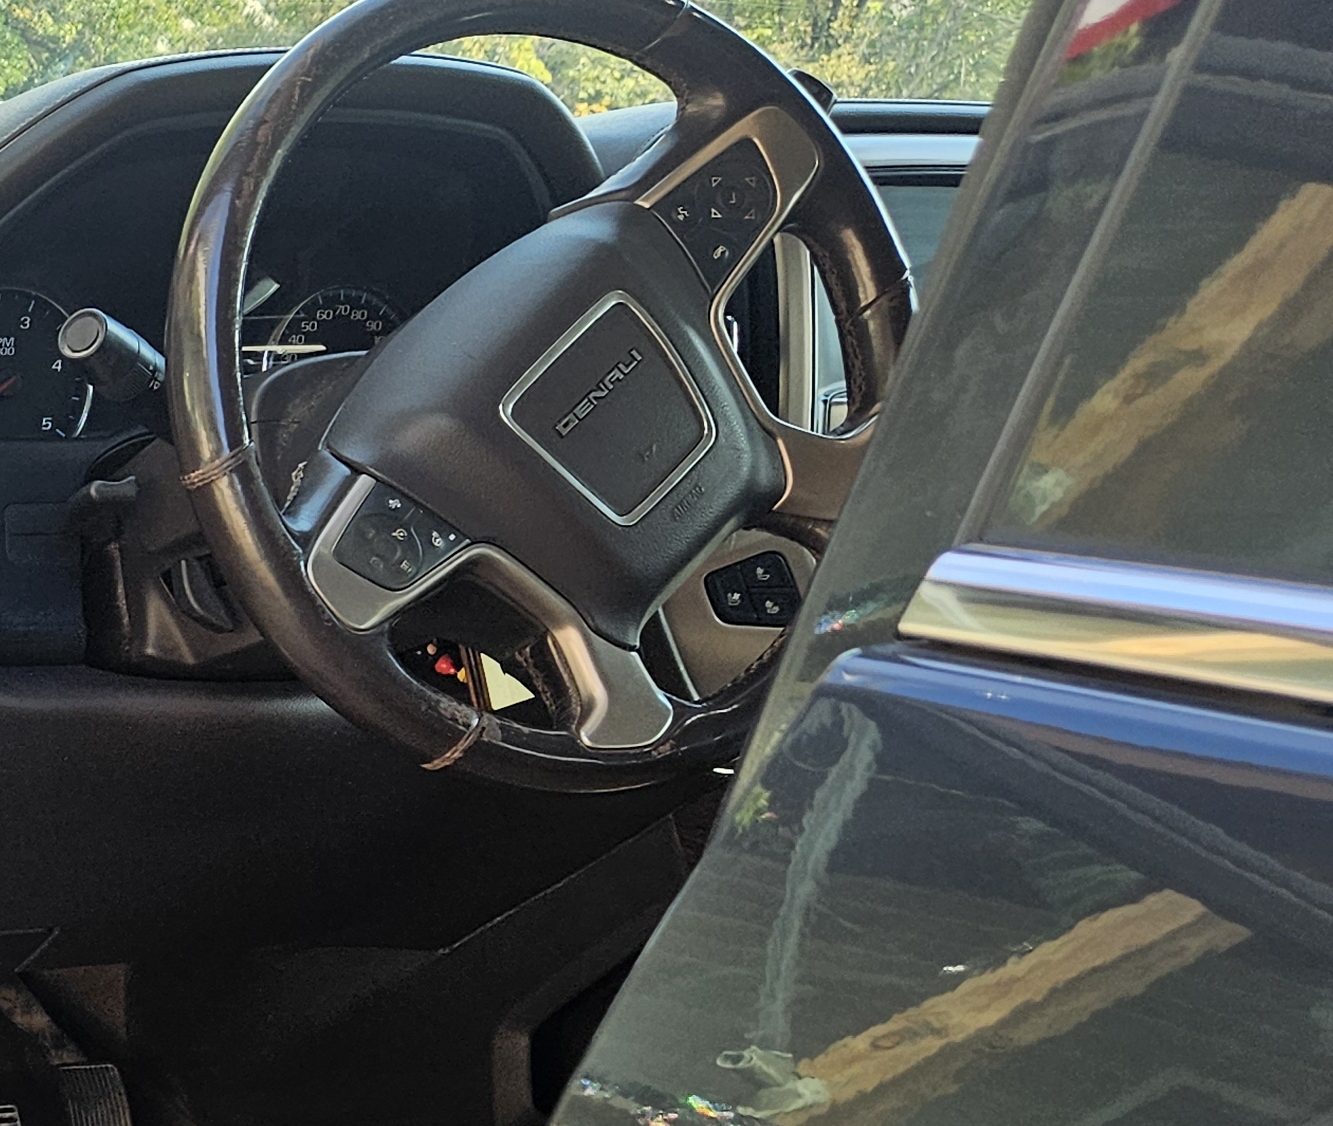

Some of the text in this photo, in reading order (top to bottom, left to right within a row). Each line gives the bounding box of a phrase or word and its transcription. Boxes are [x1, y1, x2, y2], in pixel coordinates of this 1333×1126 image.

[316, 310, 333, 320] 60
[335, 304, 350, 316] 70
[350, 310, 367, 320] 80
[20, 316, 30, 329] 3
[301, 321, 317, 331] 50
[366, 320, 382, 331] 90
[288, 334, 305, 345] 40
[51, 359, 62, 372] 4
[555, 349, 643, 437] DENALI
[41, 417, 52, 430] 5
